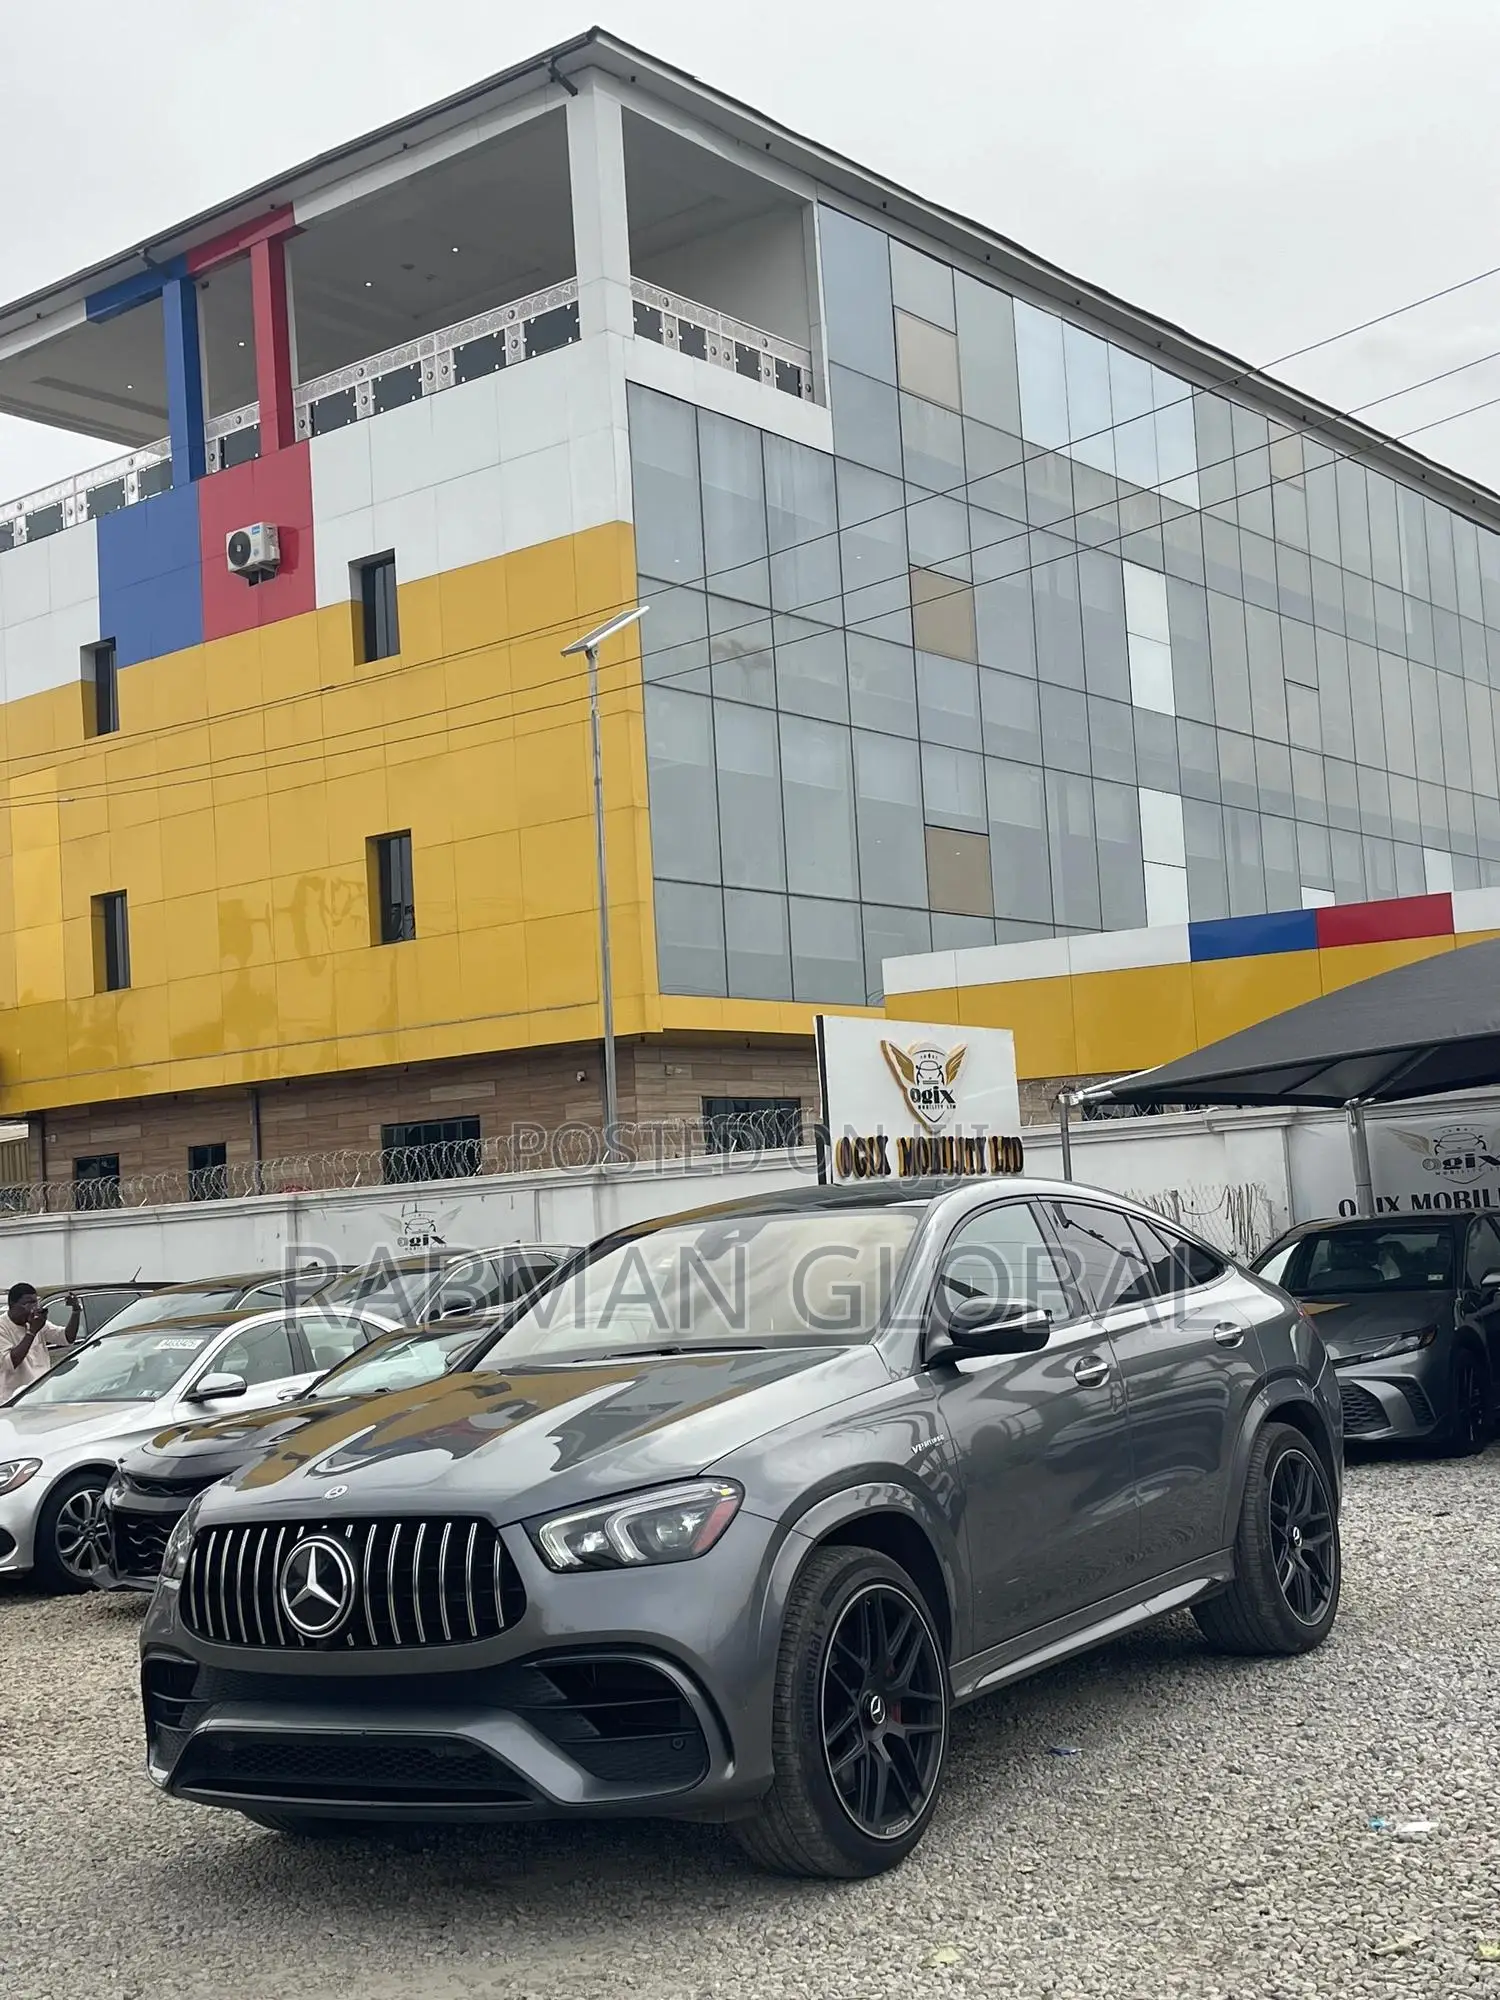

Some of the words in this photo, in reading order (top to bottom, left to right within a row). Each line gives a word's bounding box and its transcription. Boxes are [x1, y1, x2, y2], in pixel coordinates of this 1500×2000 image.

[836, 1135, 891, 1178] OGIX
[896, 1135, 986, 1177] MOBILITY
[988, 1135, 1024, 1173] LTD
[1338, 1195, 1400, 1217] OIX
[1411, 1188, 1500, 1211] MOBIL
